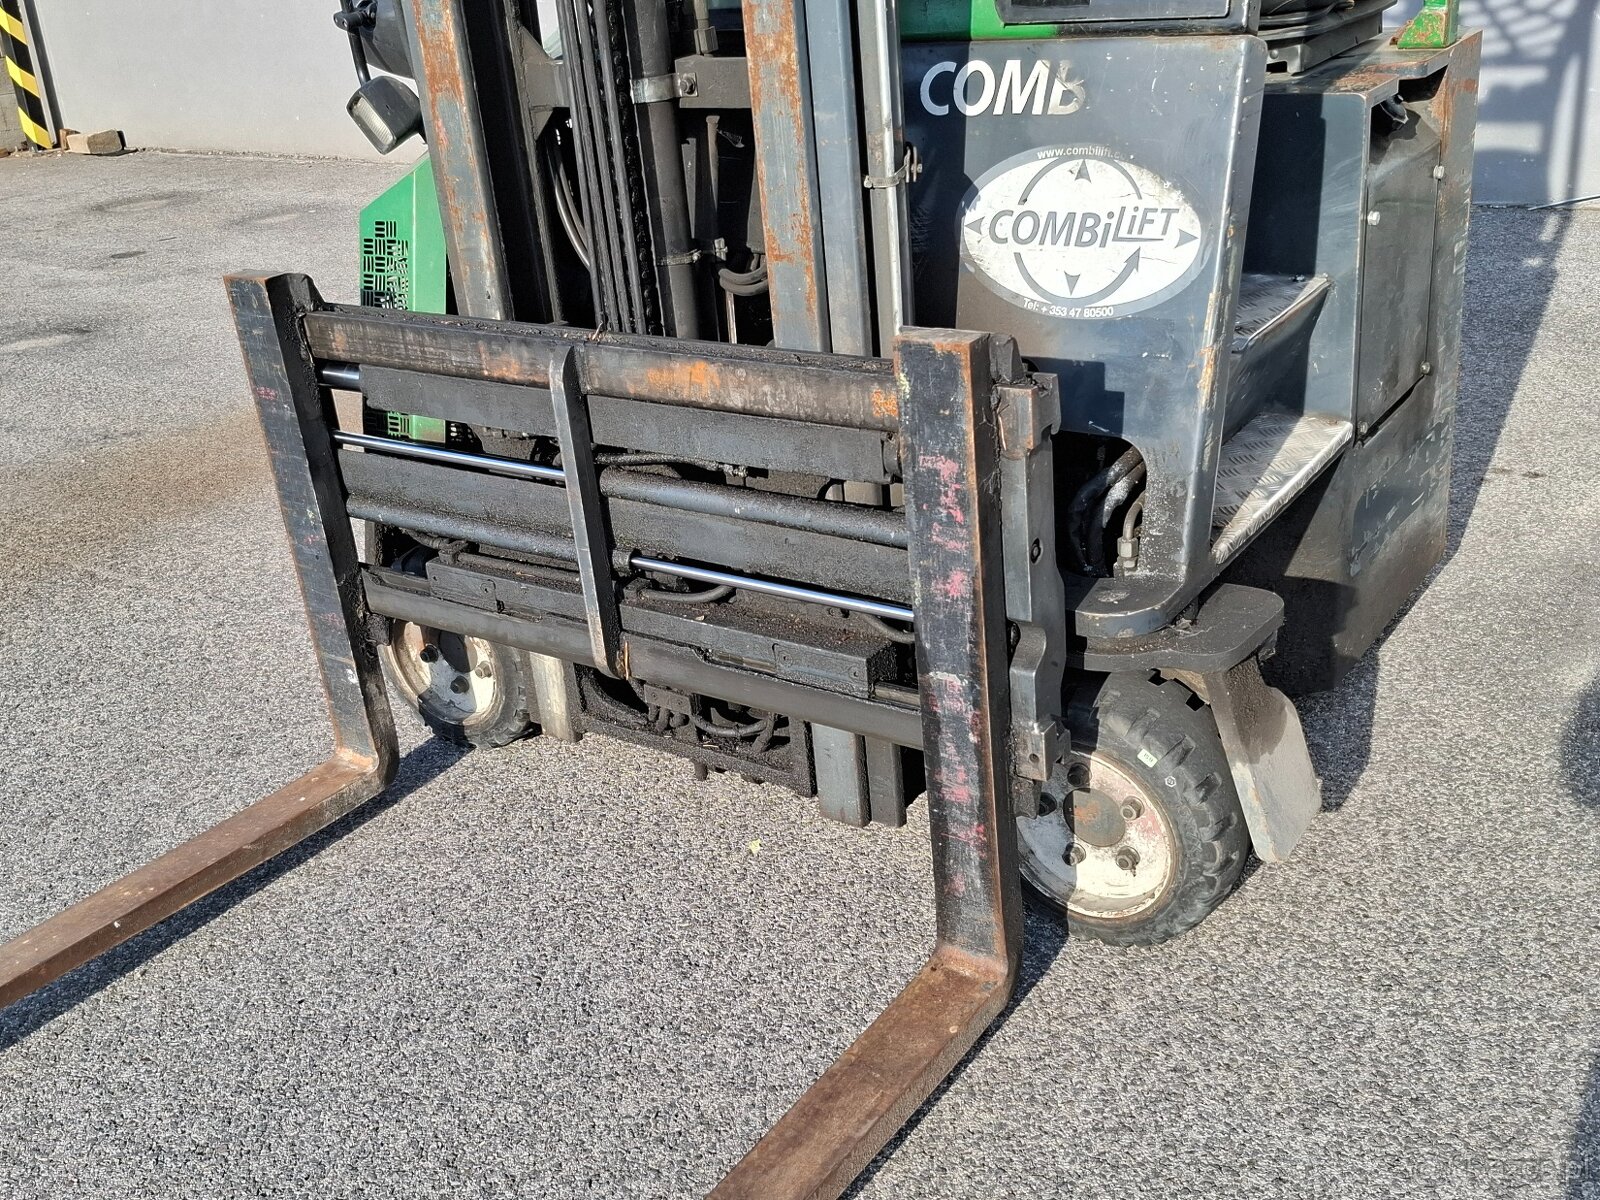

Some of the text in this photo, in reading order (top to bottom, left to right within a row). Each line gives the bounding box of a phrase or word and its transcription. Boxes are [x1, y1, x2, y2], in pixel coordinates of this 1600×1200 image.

[1023, 298, 1039, 311] Tel:
[1049, 305, 1067, 317] 353
[1069, 307, 1081, 317] 47
[1083, 307, 1114, 318] 80500
